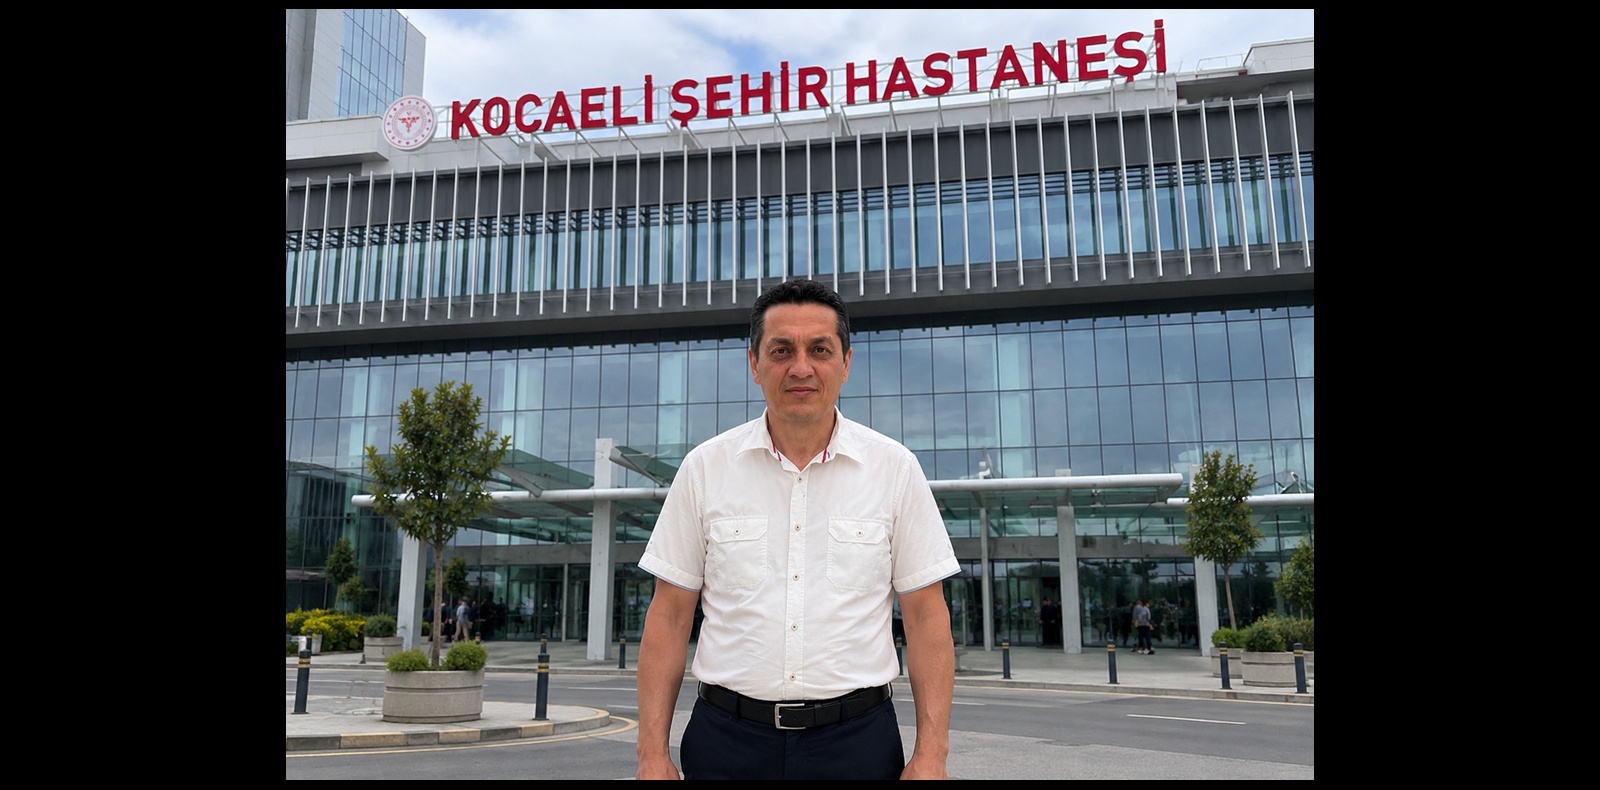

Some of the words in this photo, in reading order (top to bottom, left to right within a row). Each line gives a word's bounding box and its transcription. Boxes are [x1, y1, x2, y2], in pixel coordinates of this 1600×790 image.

[451, 74, 653, 140] KOCAELİ
[670, 61, 829, 127] ŞEHİR
[845, 19, 1167, 104] HASTANEŞİ
